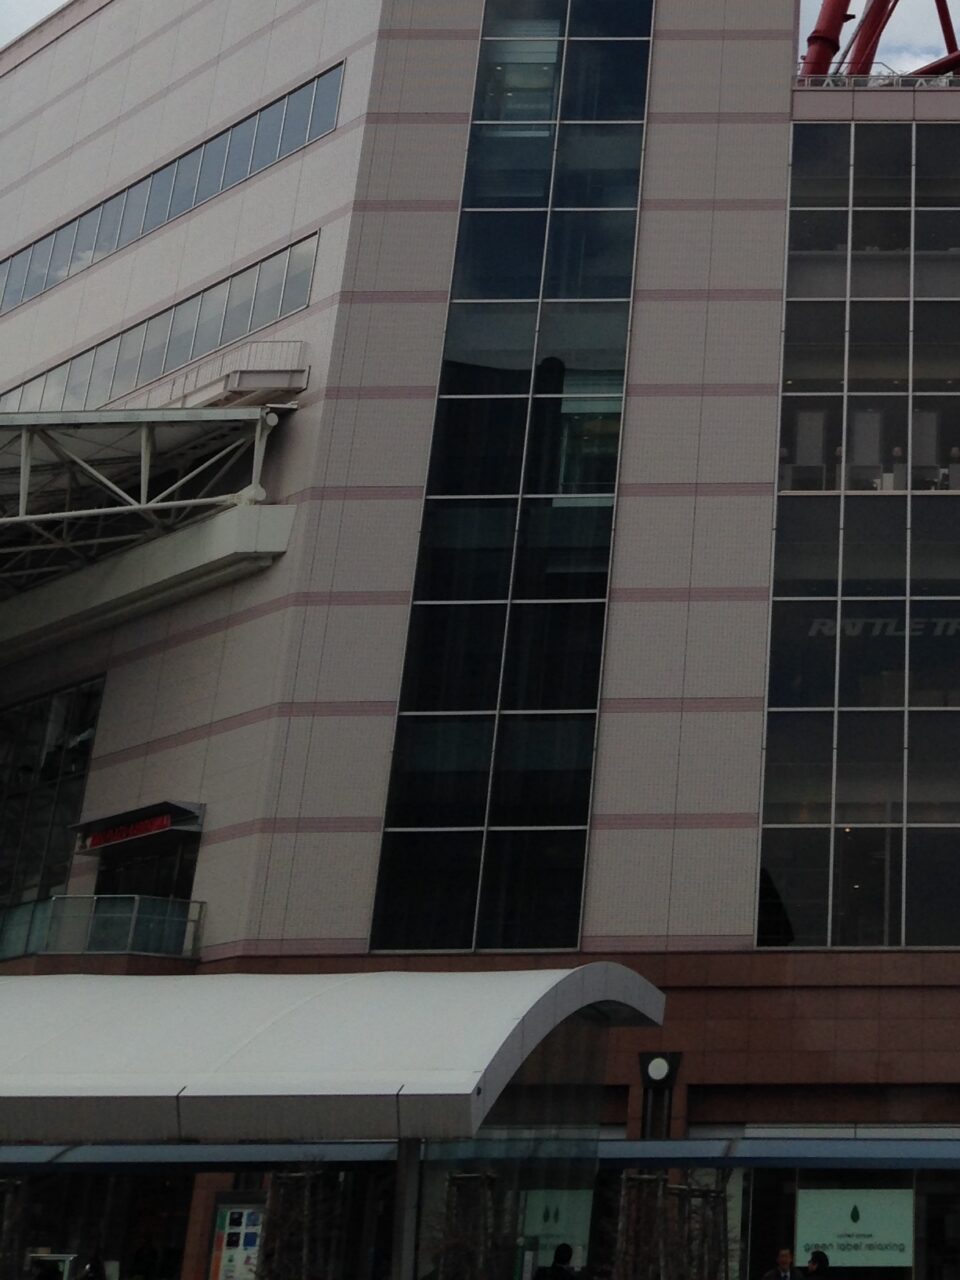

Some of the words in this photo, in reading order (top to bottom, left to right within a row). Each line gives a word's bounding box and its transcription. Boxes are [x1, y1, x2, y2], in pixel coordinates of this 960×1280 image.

[804, 1243, 834, 1252] green
[837, 1242, 862, 1251] label
[865, 1242, 905, 1252] relaxing
